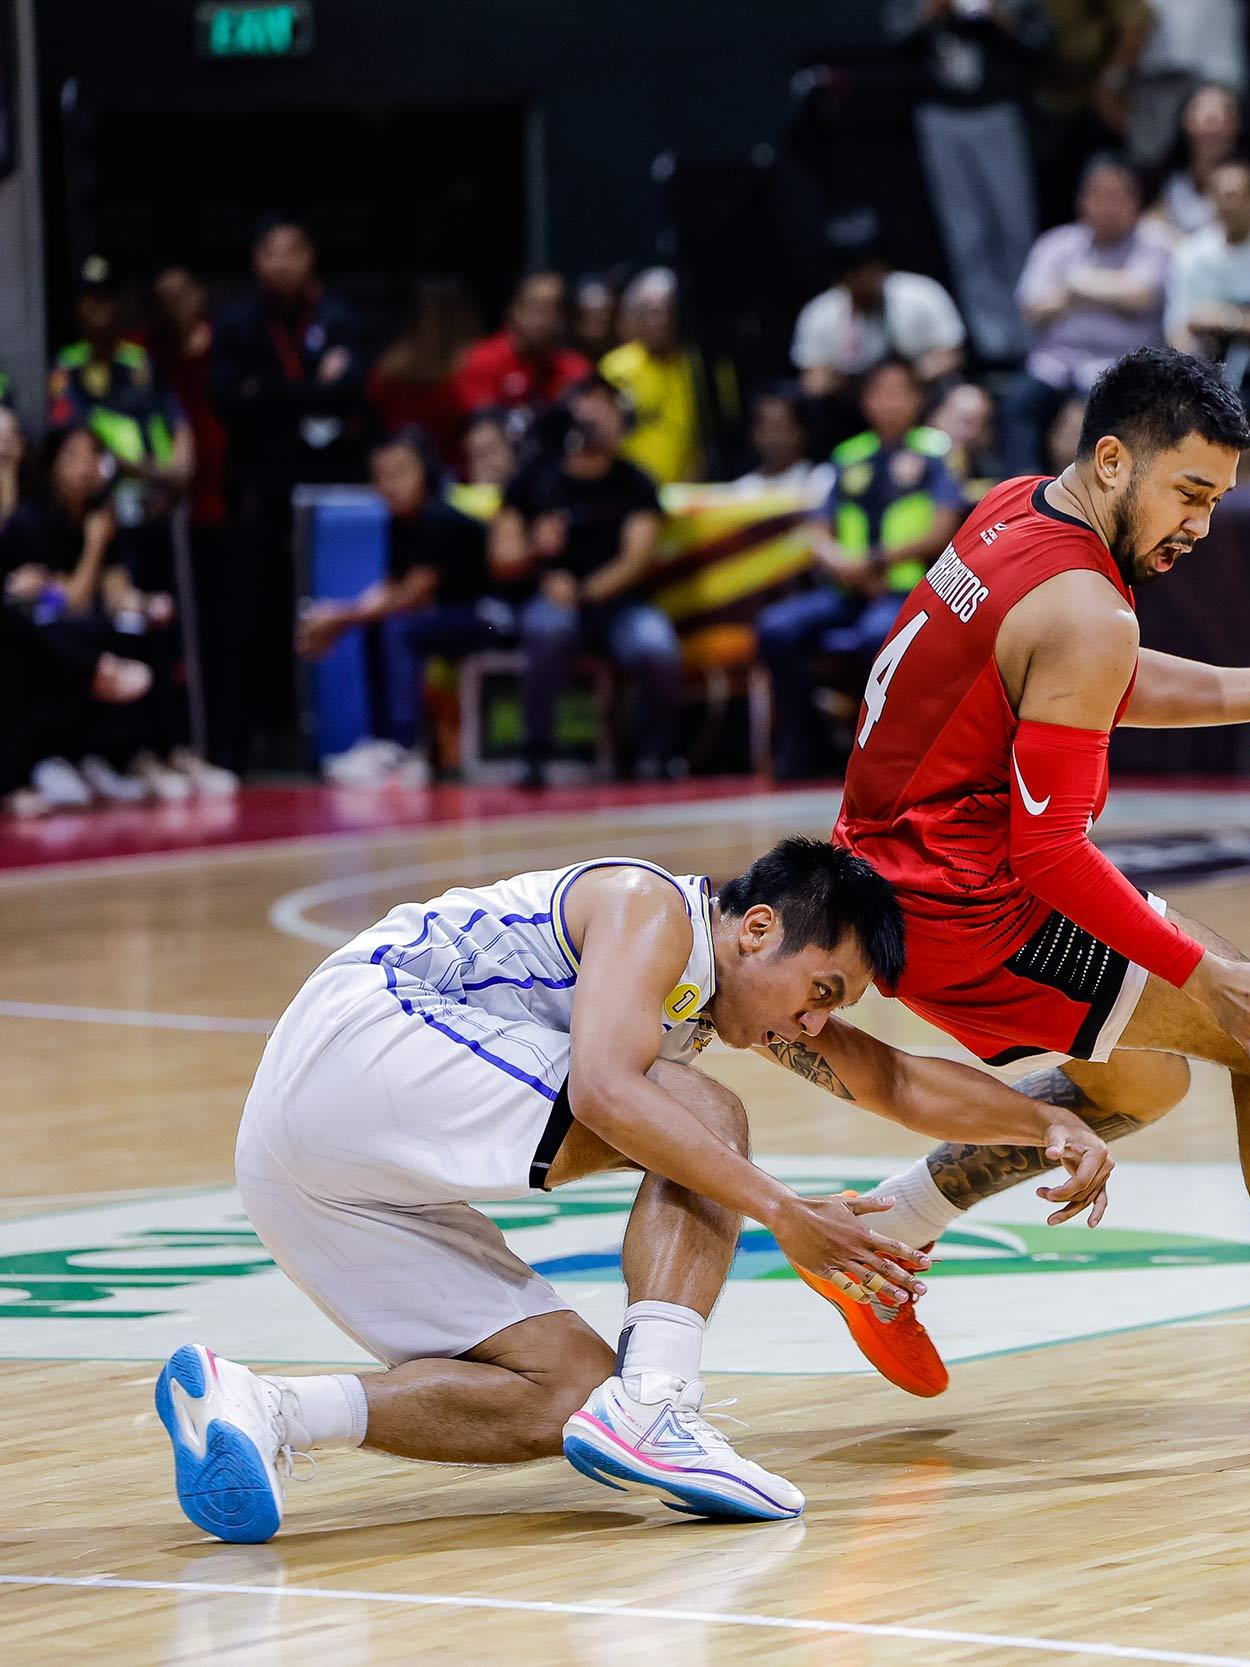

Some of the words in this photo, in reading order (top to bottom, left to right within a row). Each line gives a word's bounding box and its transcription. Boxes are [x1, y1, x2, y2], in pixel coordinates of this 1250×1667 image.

[924, 540, 991, 625] ARRIENTOS
[857, 609, 930, 751] 4
[672, 989, 696, 1014] 1
